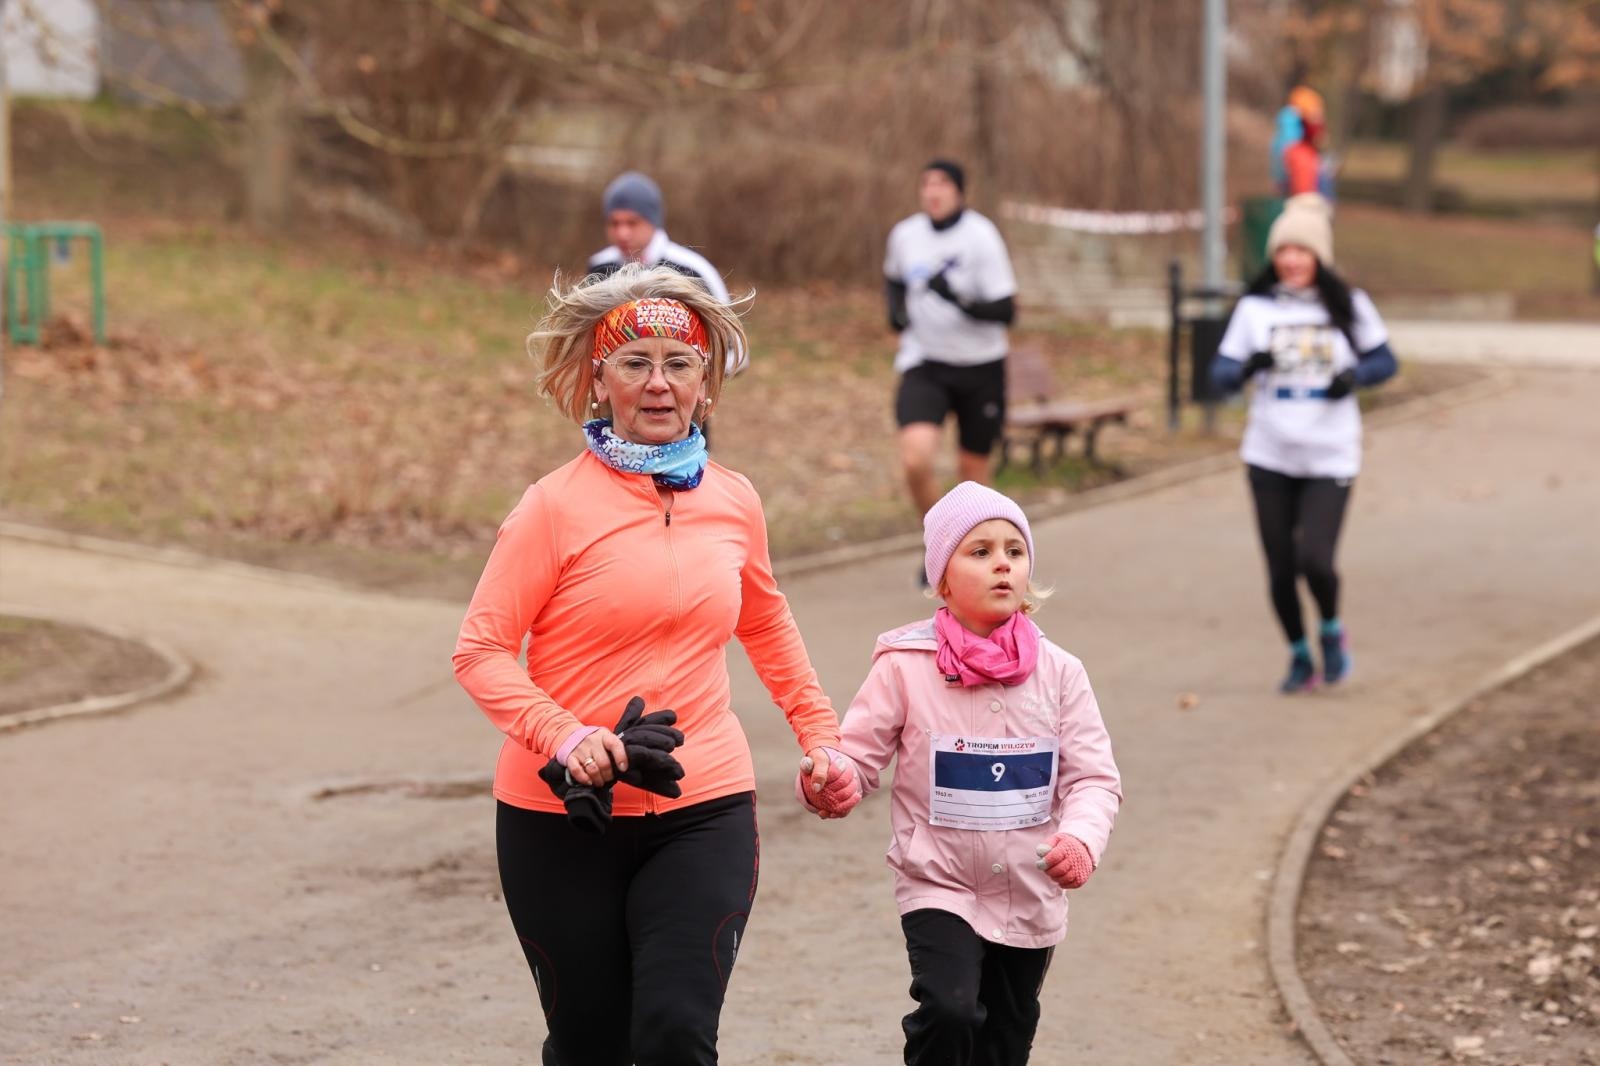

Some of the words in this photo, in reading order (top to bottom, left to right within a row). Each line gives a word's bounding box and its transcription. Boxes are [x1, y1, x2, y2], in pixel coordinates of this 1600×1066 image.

[966, 741, 999, 750] TROPEM
[1000, 742, 1036, 750] WILCZYM
[991, 762, 1006, 782] 9
